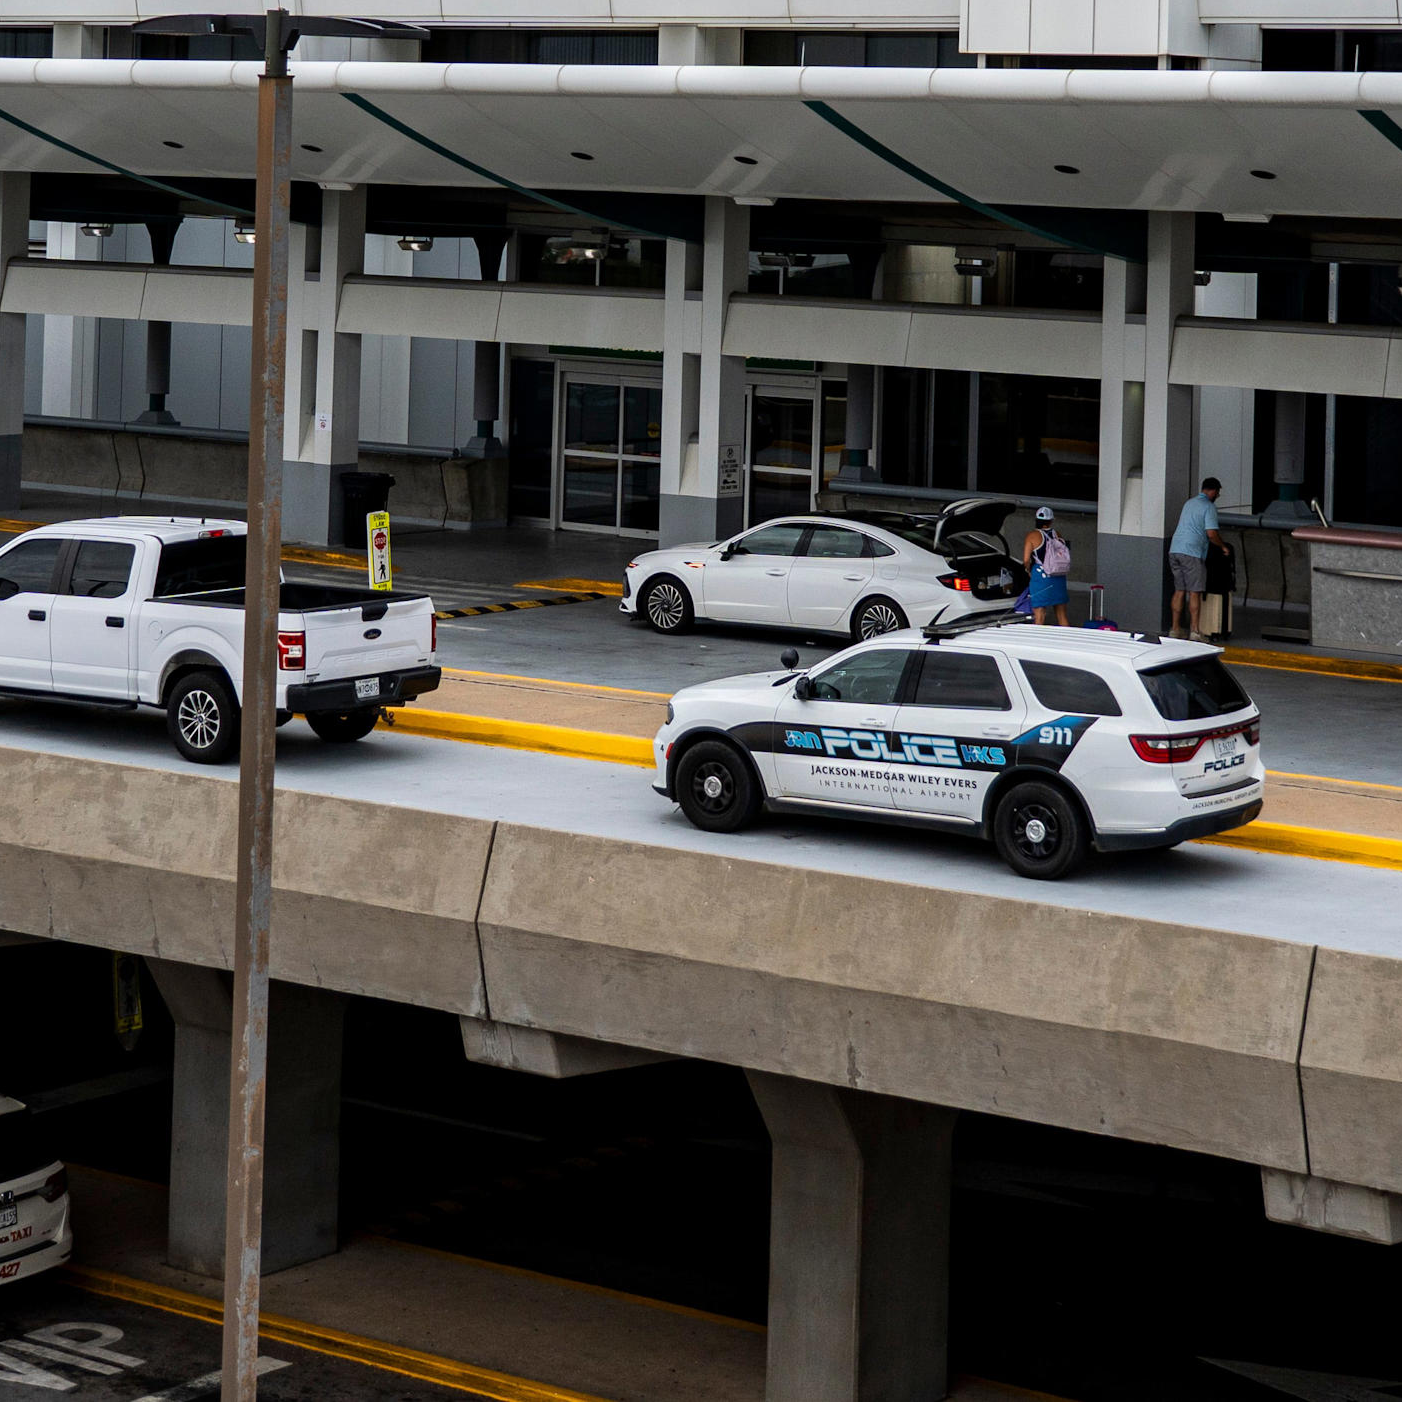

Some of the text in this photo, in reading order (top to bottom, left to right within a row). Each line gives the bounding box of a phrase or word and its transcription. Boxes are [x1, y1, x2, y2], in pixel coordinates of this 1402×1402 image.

[1038, 726, 1073, 746] 911
[820, 727, 963, 767] POLICE
[960, 745, 1006, 765] HKS
[1204, 753, 1245, 773] POLICE
[811, 764, 978, 789] JACKSON-MEDGAR WILEY EVERS
[819, 779, 972, 801] INTERNATIONAL AIRPORT
[10, 1226, 32, 1242] TAXI
